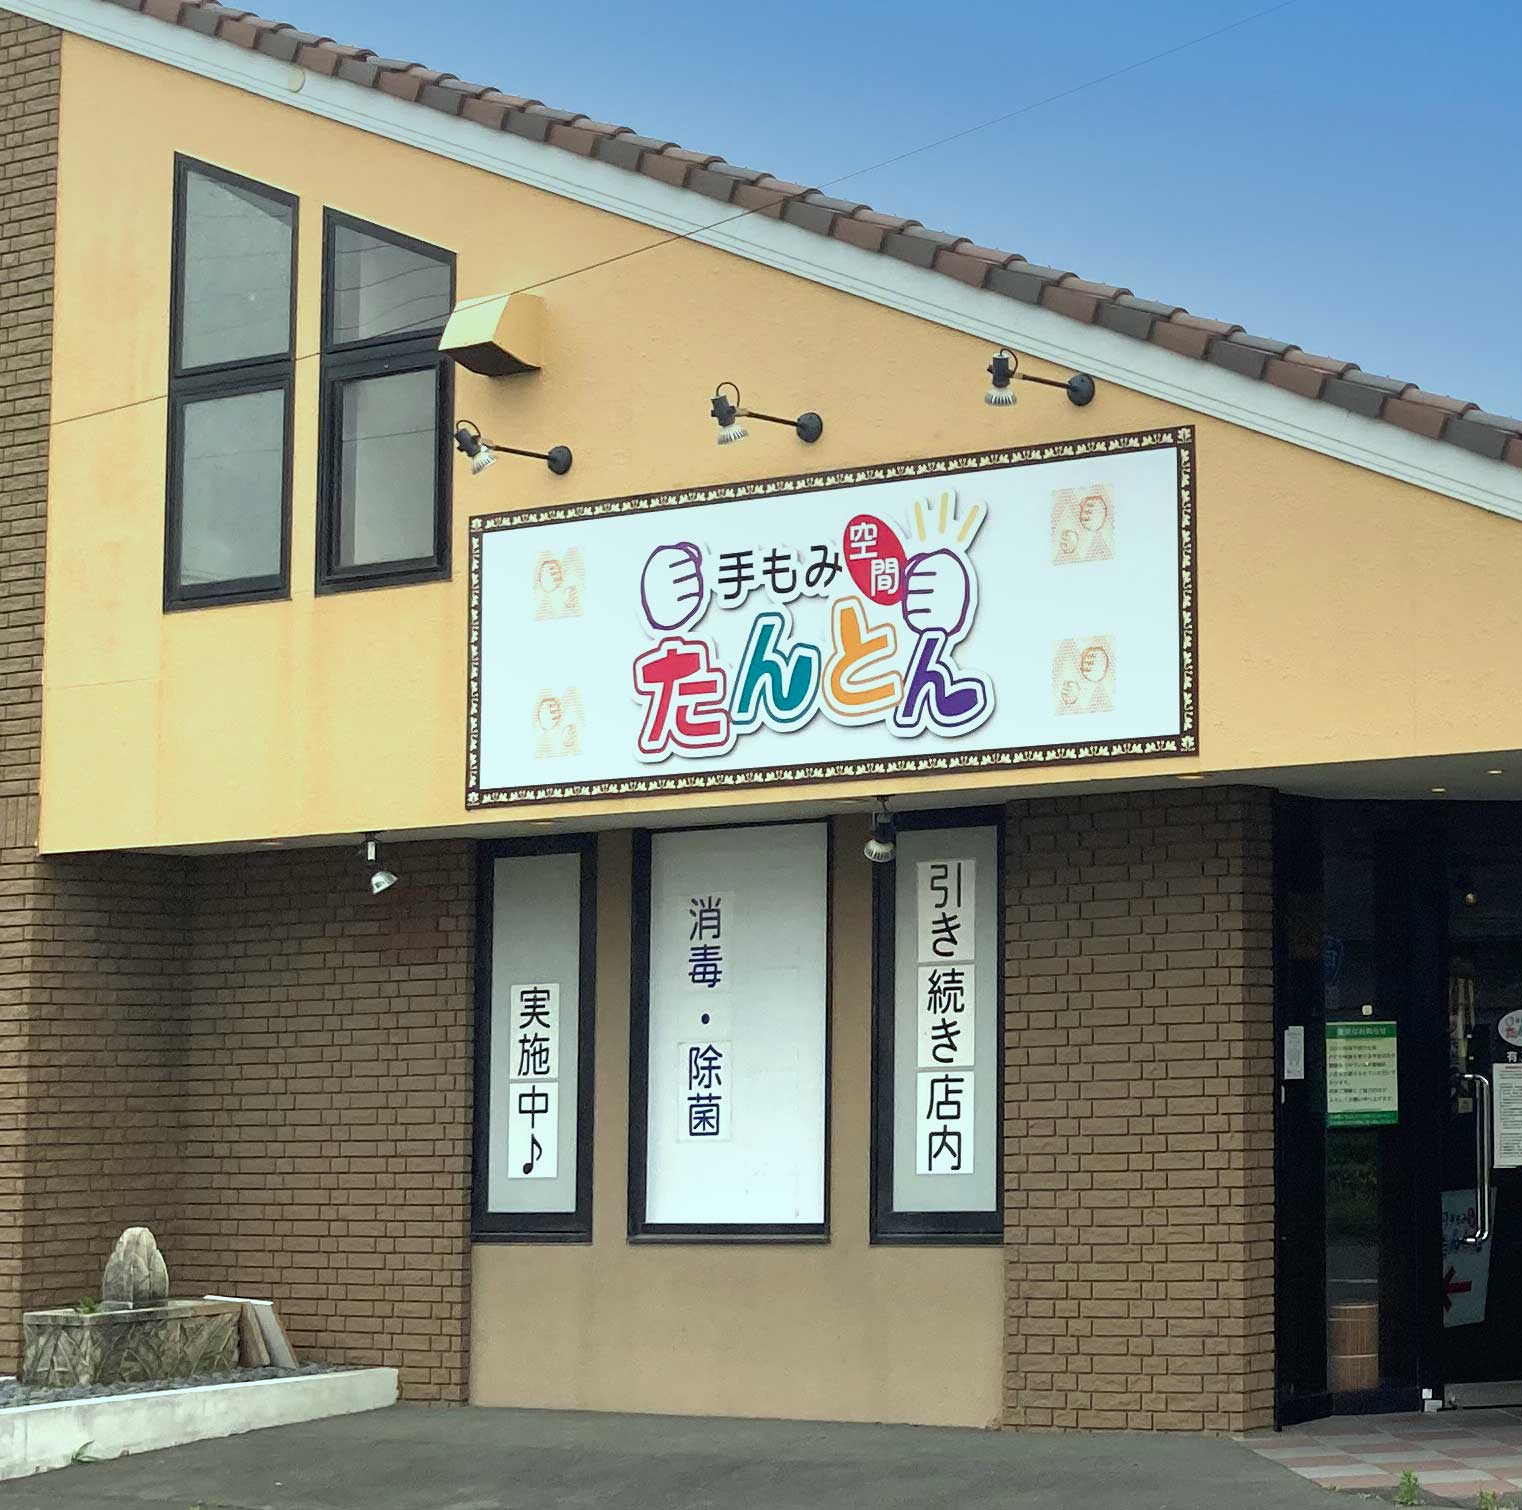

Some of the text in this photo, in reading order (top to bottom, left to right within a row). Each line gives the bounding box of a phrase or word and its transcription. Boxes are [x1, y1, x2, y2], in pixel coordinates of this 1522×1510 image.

[718, 521, 900, 600] 手もみ 空間
[634, 594, 986, 754] たんとん
[687, 895, 723, 1138] 消毒・除菌
[926, 863, 965, 1172] 引き続き店内
